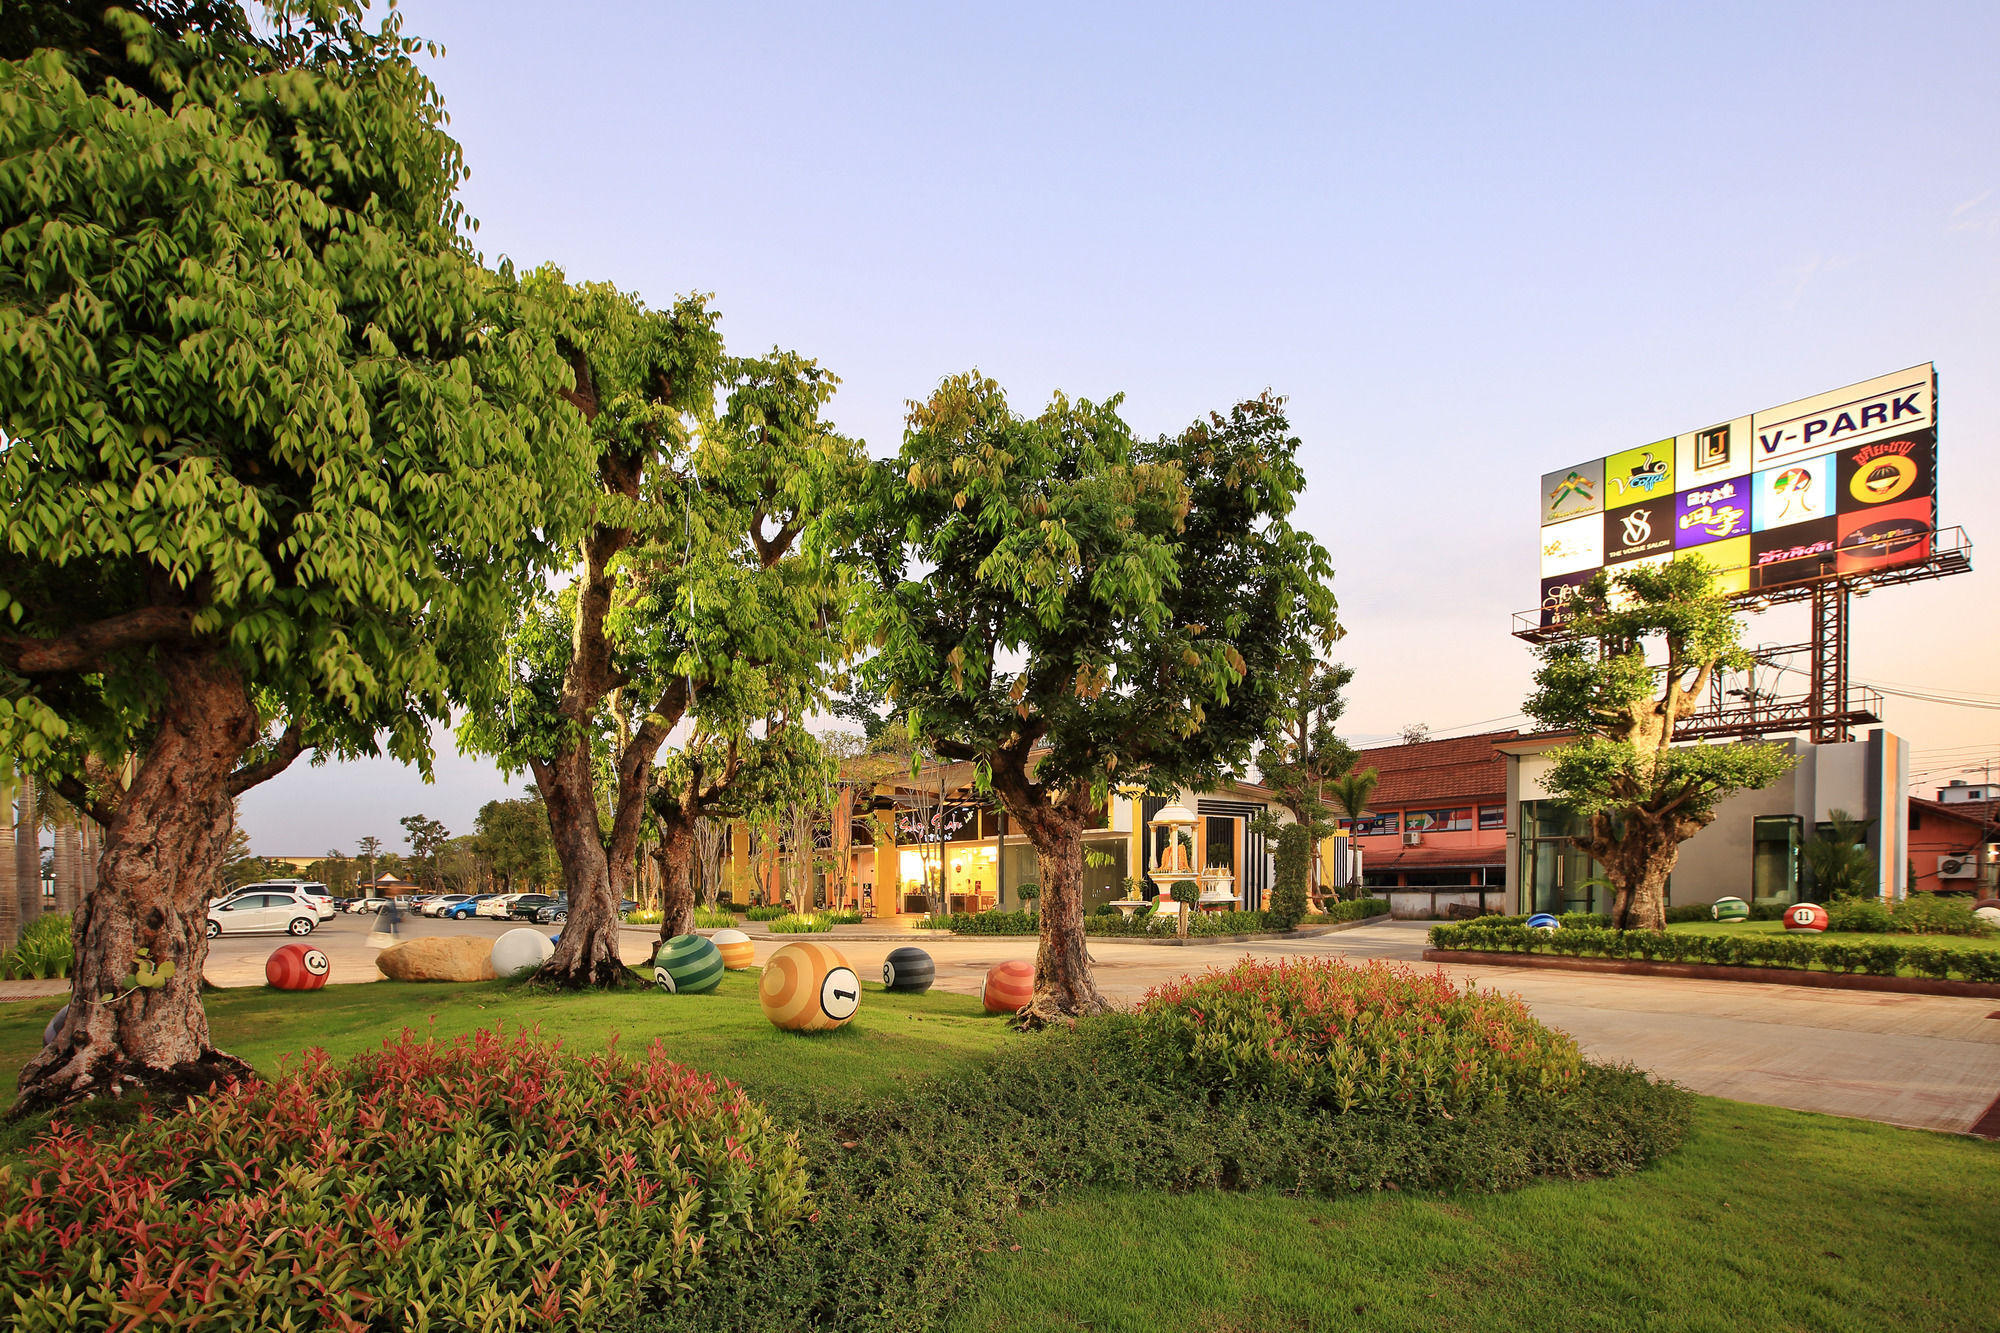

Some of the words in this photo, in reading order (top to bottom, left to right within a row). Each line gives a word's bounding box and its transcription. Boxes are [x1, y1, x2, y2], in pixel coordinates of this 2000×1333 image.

[1759, 391, 1922, 454] V-PARK
[1608, 550, 1623, 558] THE
[1622, 544, 1647, 555] VOGUE
[1646, 539, 1671, 550] SALON
[1797, 911, 1810, 921] 11
[309, 956, 327, 969] 3
[883, 963, 890, 984] 8
[833, 988, 857, 1003] 1
